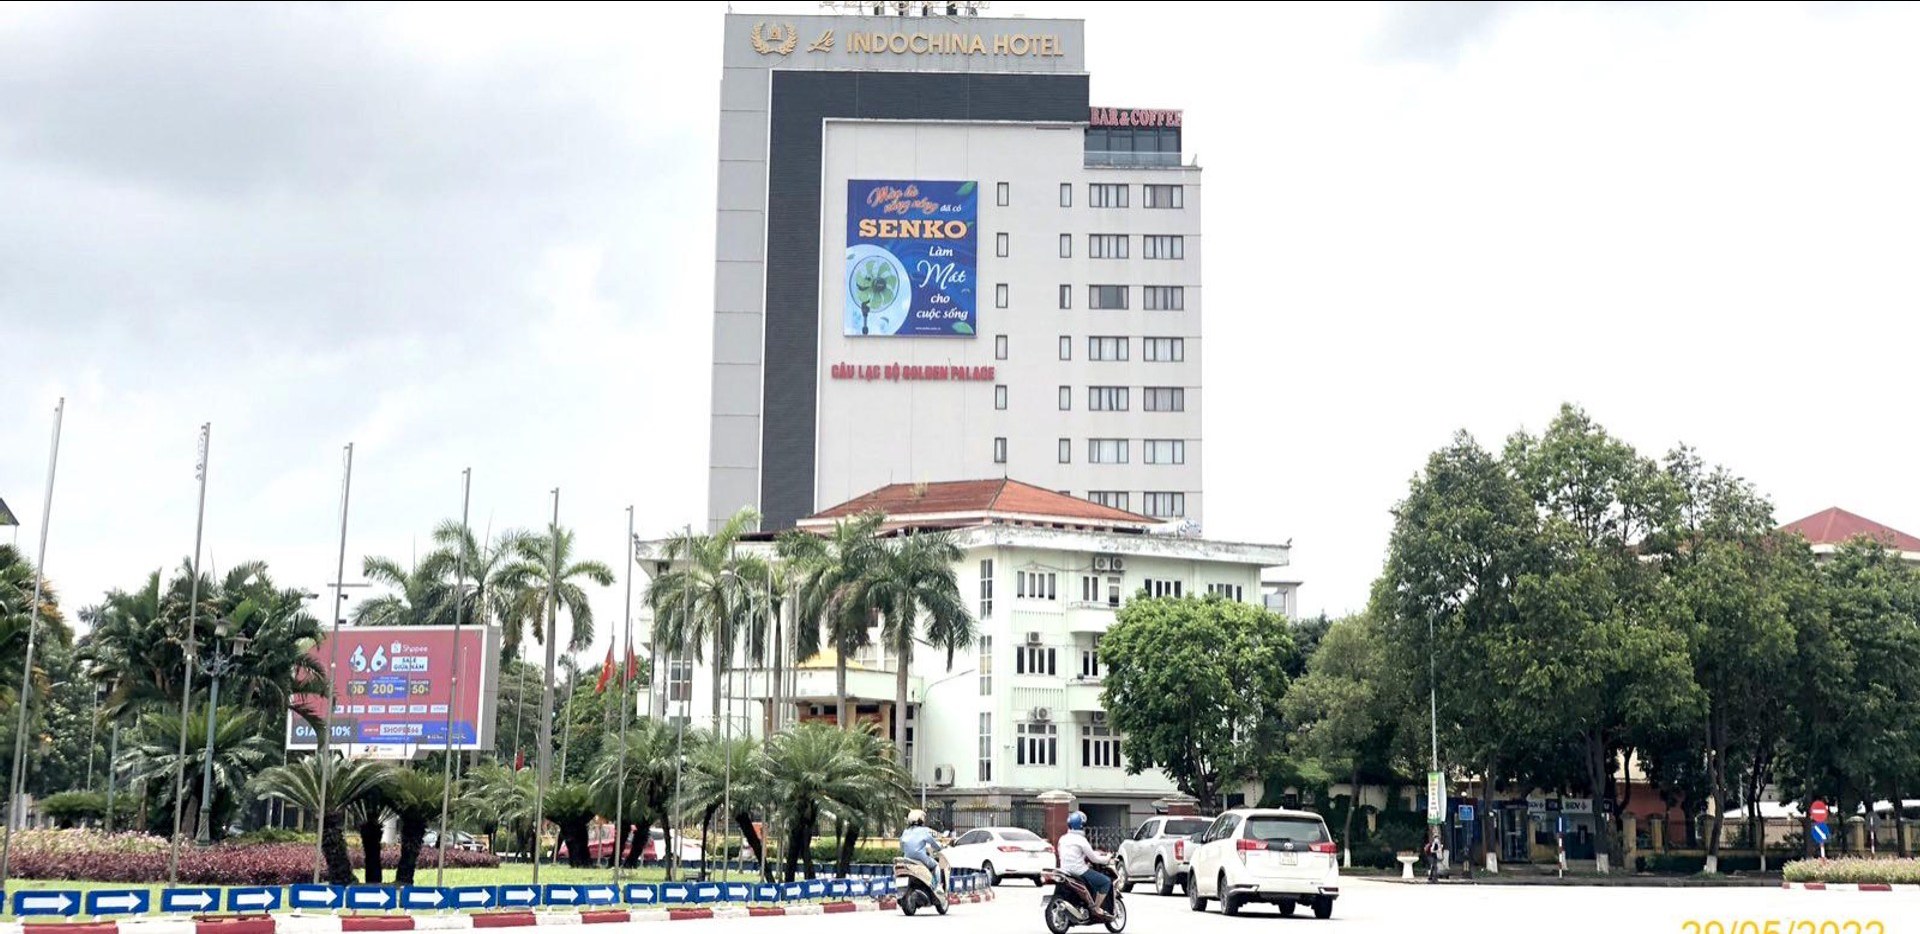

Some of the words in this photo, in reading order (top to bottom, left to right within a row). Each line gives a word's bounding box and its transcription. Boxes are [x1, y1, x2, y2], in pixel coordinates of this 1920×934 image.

[847, 32, 986, 56] INDOCHINA
[993, 34, 1064, 57] HOTEL
[858, 219, 968, 239] SENKO
[929, 245, 953, 257] Làm
[917, 259, 966, 290] Mát
[930, 293, 951, 304] cho
[916, 307, 941, 320] cuộc
[943, 307, 969, 321] sống
[902, 366, 948, 381] GOLDEN
[950, 366, 995, 381] PALACE
[350, 645, 388, 673] 6.6
[372, 684, 394, 694] 200
[331, 725, 350, 737] 10%
